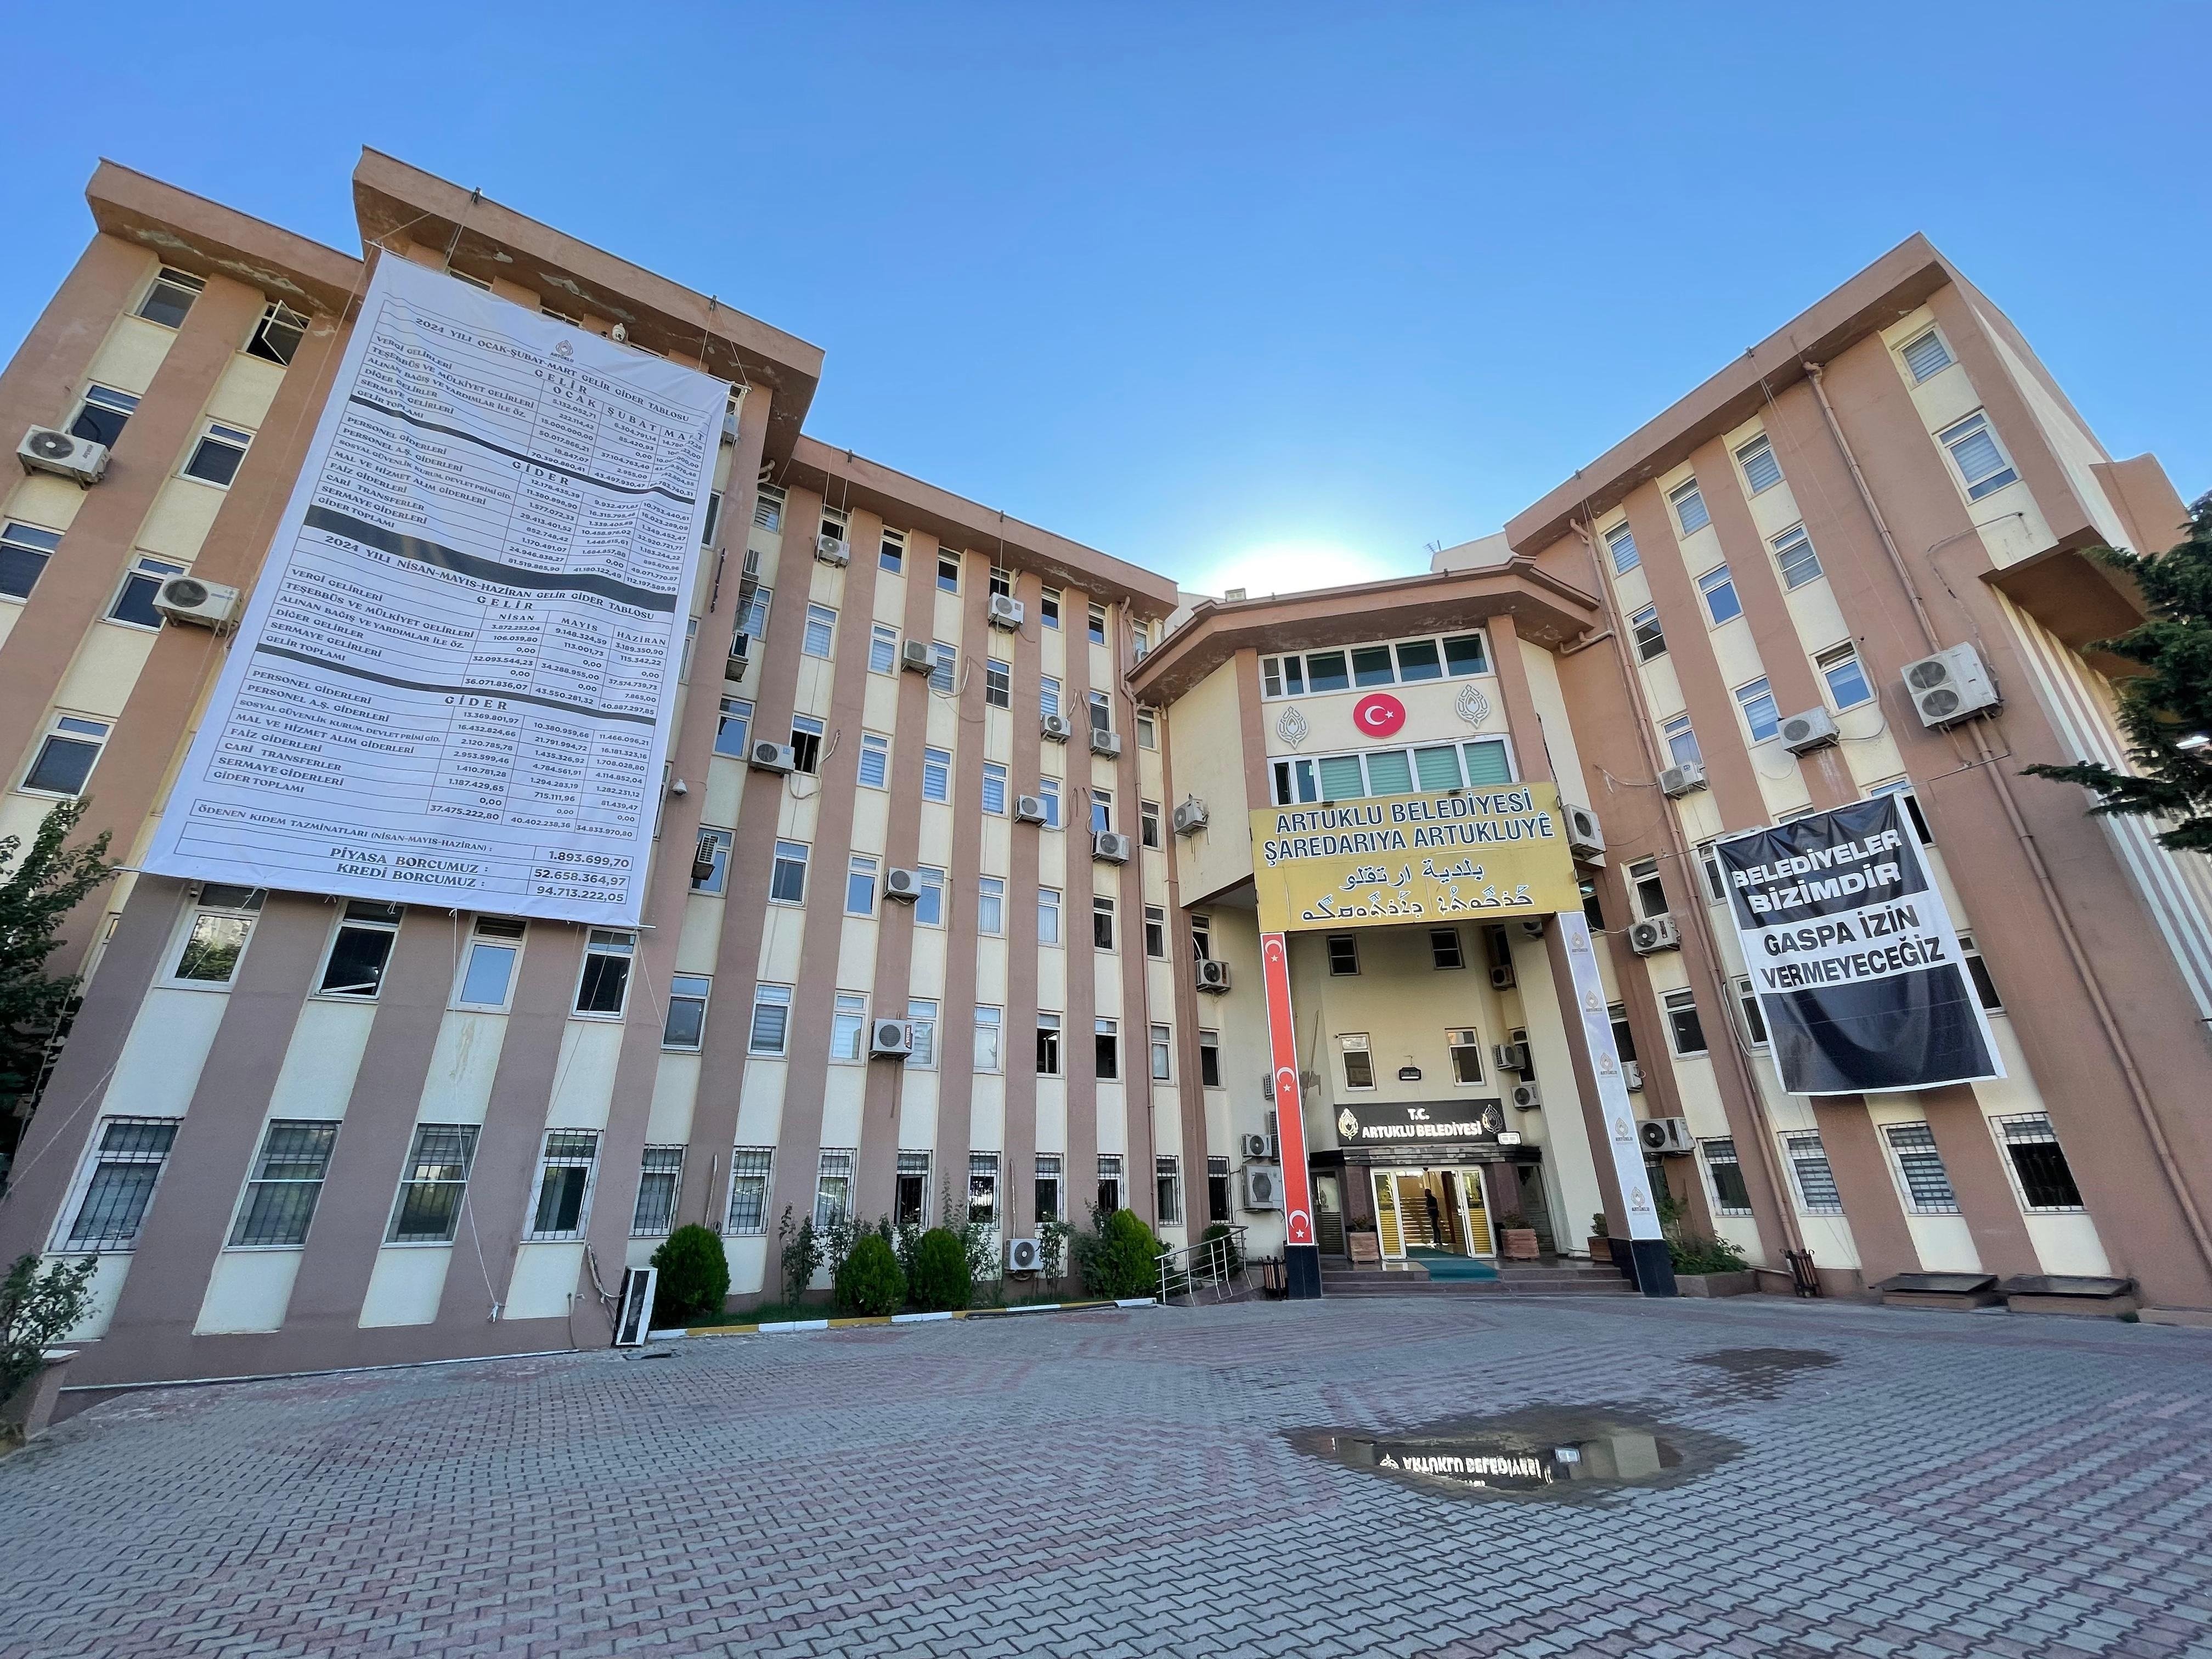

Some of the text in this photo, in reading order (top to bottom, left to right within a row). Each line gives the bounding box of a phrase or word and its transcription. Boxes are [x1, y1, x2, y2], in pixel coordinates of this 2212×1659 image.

[416, 318, 690, 422] 2024 YILI OCAK-ŞUBAT-MART GELİR GİDER TABLOSU
[488, 389, 534, 408] GELİRLERİ
[334, 451, 356, 462] MAL
[359, 459, 372, 468] VE
[439, 487, 486, 505] GİDERLERİ
[416, 454, 462, 472] GİDERLERİ
[318, 497, 349, 512] GİDER
[352, 508, 394, 528] TOPLAMI
[321, 486, 427, 524] SERMAYE GİDERLERİ
[326, 475, 425, 511] CARİ TRANSFERLER
[291, 569, 325, 583] VERGİ
[329, 579, 383, 602] GELİRLERİ
[325, 535, 359, 551] 2024
[365, 548, 390, 563] YILI
[397, 560, 532, 599] NİSAN-MAYIS-HAZİRAN
[571, 592, 603, 606] GİDER
[608, 602, 654, 620] TABLOSU
[276, 608, 364, 639] DİĞER GELİRLER
[280, 595, 321, 611] ALINAN
[324, 607, 356, 623] BAĞIŞ
[359, 618, 373, 627] VE
[374, 622, 430, 642] YARDIMLAR
[433, 636, 448, 646] İLE
[583, 660, 602, 668] 0,00
[286, 582, 345, 604] TEŞEBBÜS
[348, 600, 363, 610] VE
[365, 607, 420, 626] MÜLKİYET
[423, 623, 475, 637] GELİRLERİ
[564, 642, 604, 657] 113.001,73
[561, 618, 598, 631] MAYIS
[617, 631, 666, 645] HAZİRAN
[266, 635, 594, 705] GELİR TOPLAMI 36.071.836,07 43.550.281,32
[271, 621, 323, 640] SERMAYE
[327, 637, 382, 657] GELİRLERİ
[578, 684, 597, 692] 0,00
[247, 684, 306, 703] PERSONEL
[309, 699, 329, 709] A.Ş.
[334, 705, 390, 722] GİDERLERİ
[252, 670, 311, 689] PERSONEL
[315, 686, 372, 704] GİDERLERİ
[236, 713, 261, 724] MAL
[266, 719, 280, 728] VE
[284, 723, 328, 738] HİZMET
[330, 734, 357, 745] ALIM
[361, 740, 414, 754] GİDERLERİ
[240, 699, 276, 712] SOSYAL
[279, 707, 328, 724] GÜVENLİK
[366, 727, 399, 739] DEVLET
[230, 728, 257, 739] FAİZ
[261, 734, 323, 753] GİDERLERİ
[218, 757, 278, 774] SERMAYE
[280, 769, 345, 786] GİDERLERİ
[479, 798, 502, 806] 0,00
[224, 742, 638, 811] CARİ TRANSFERLER 1.187.429,65 715.111,96 81.439,47
[214, 770, 632, 837] GİDER TOPLAMI 37.475.222,80 34.833.970,80
[1276, 788, 1534, 834] ARTUKLU BELEDİYESİ
[198, 804, 629, 867] ÖDENEN KIDEM TAZMİNATLARI 1.893.699,70
[1265, 812, 1555, 866] ŞAREDARIYA ARTUKLUYÊ
[330, 847, 626, 887] PİYASA BORCUMUZ 52.658.364,97
[1421, 859, 1484, 884] بلدية
[1731, 828, 1902, 888] BELEDİYELER
[336, 864, 623, 902] KREDİ BORCUMUZ 94.713.222,05
[1747, 861, 1901, 913] BİZİMDİR
[1764, 904, 1919, 956] GASPA İZİN
[1760, 934, 1946, 989] VERMEYECEĞİZ
[1362, 1120, 1482, 1139] ARTUKLU BELEDİYESİ
[1407, 1108, 1430, 1121] T.C.
